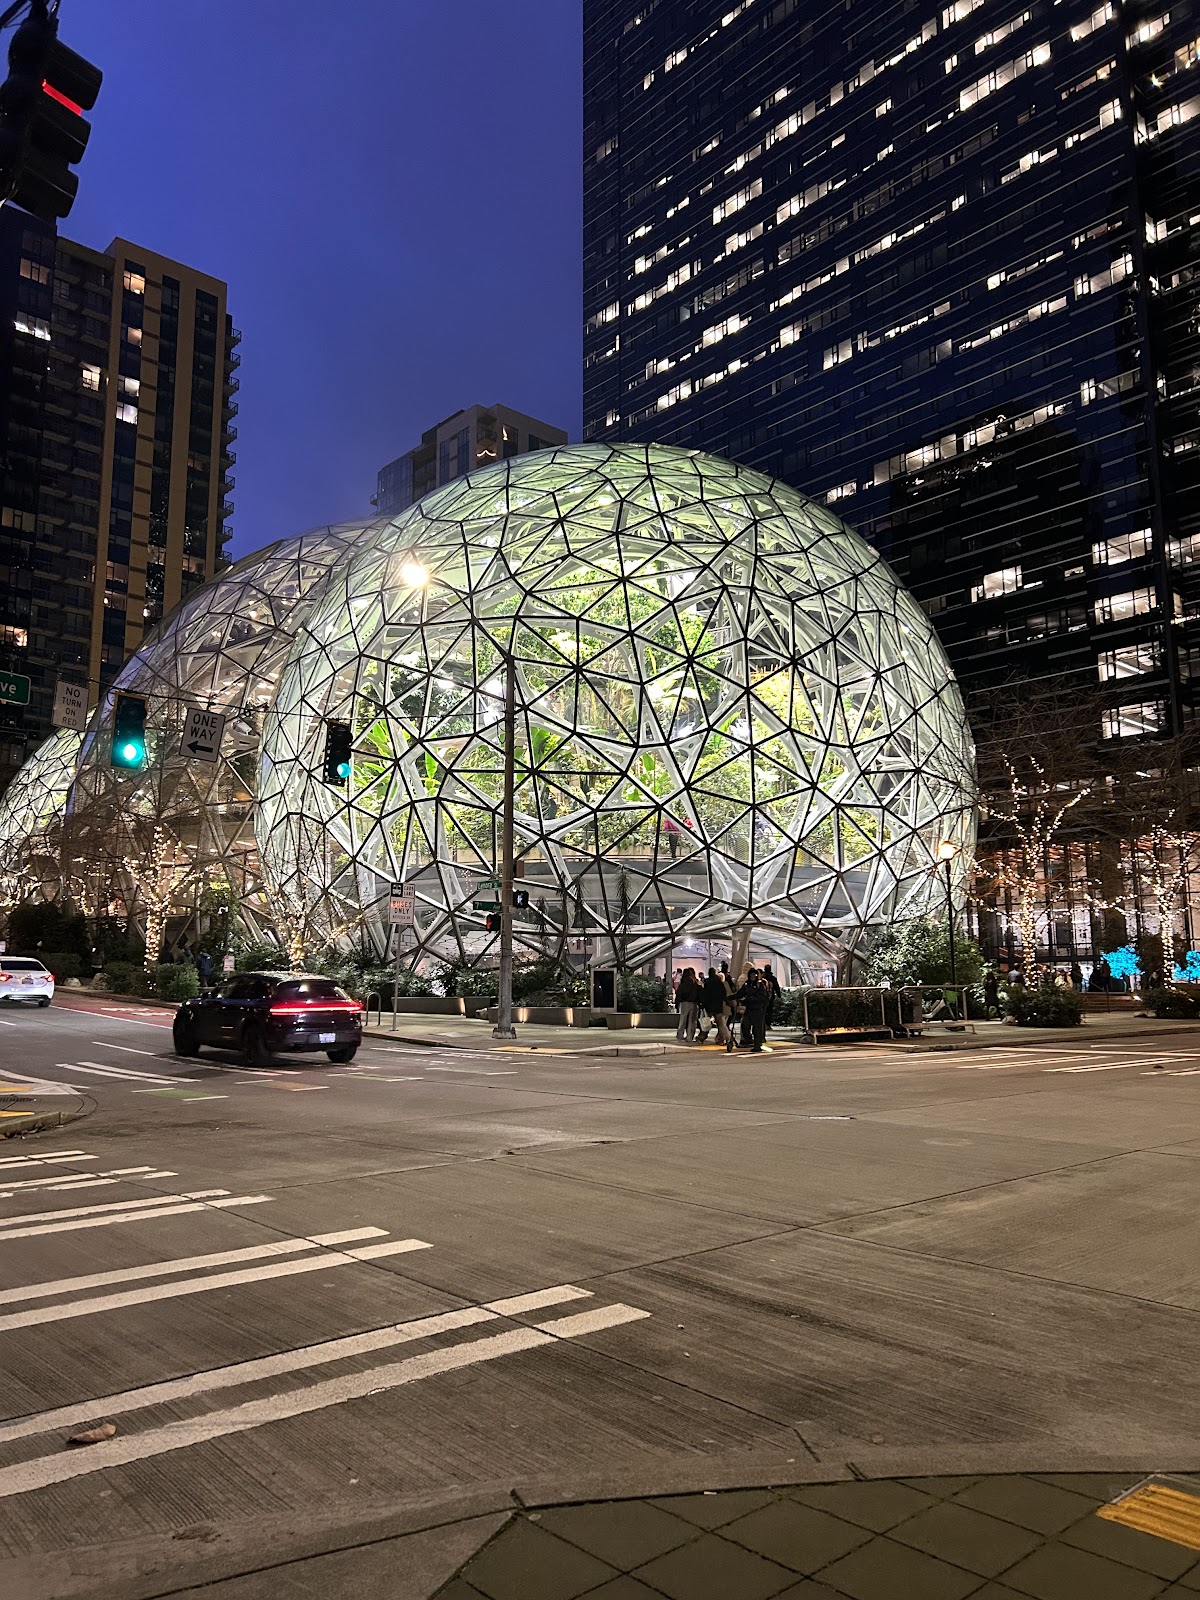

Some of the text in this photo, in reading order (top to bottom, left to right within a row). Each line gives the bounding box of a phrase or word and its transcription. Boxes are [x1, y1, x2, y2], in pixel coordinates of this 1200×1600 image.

[65, 686, 81, 698] NO
[62, 697, 82, 708] TURN
[65, 707, 76, 717] ON
[62, 716, 77, 727] RED
[193, 713, 218, 729] ONE
[190, 726, 217, 741] WAY
[392, 900, 412, 908] BUSES
[394, 907, 410, 915] ONLY
